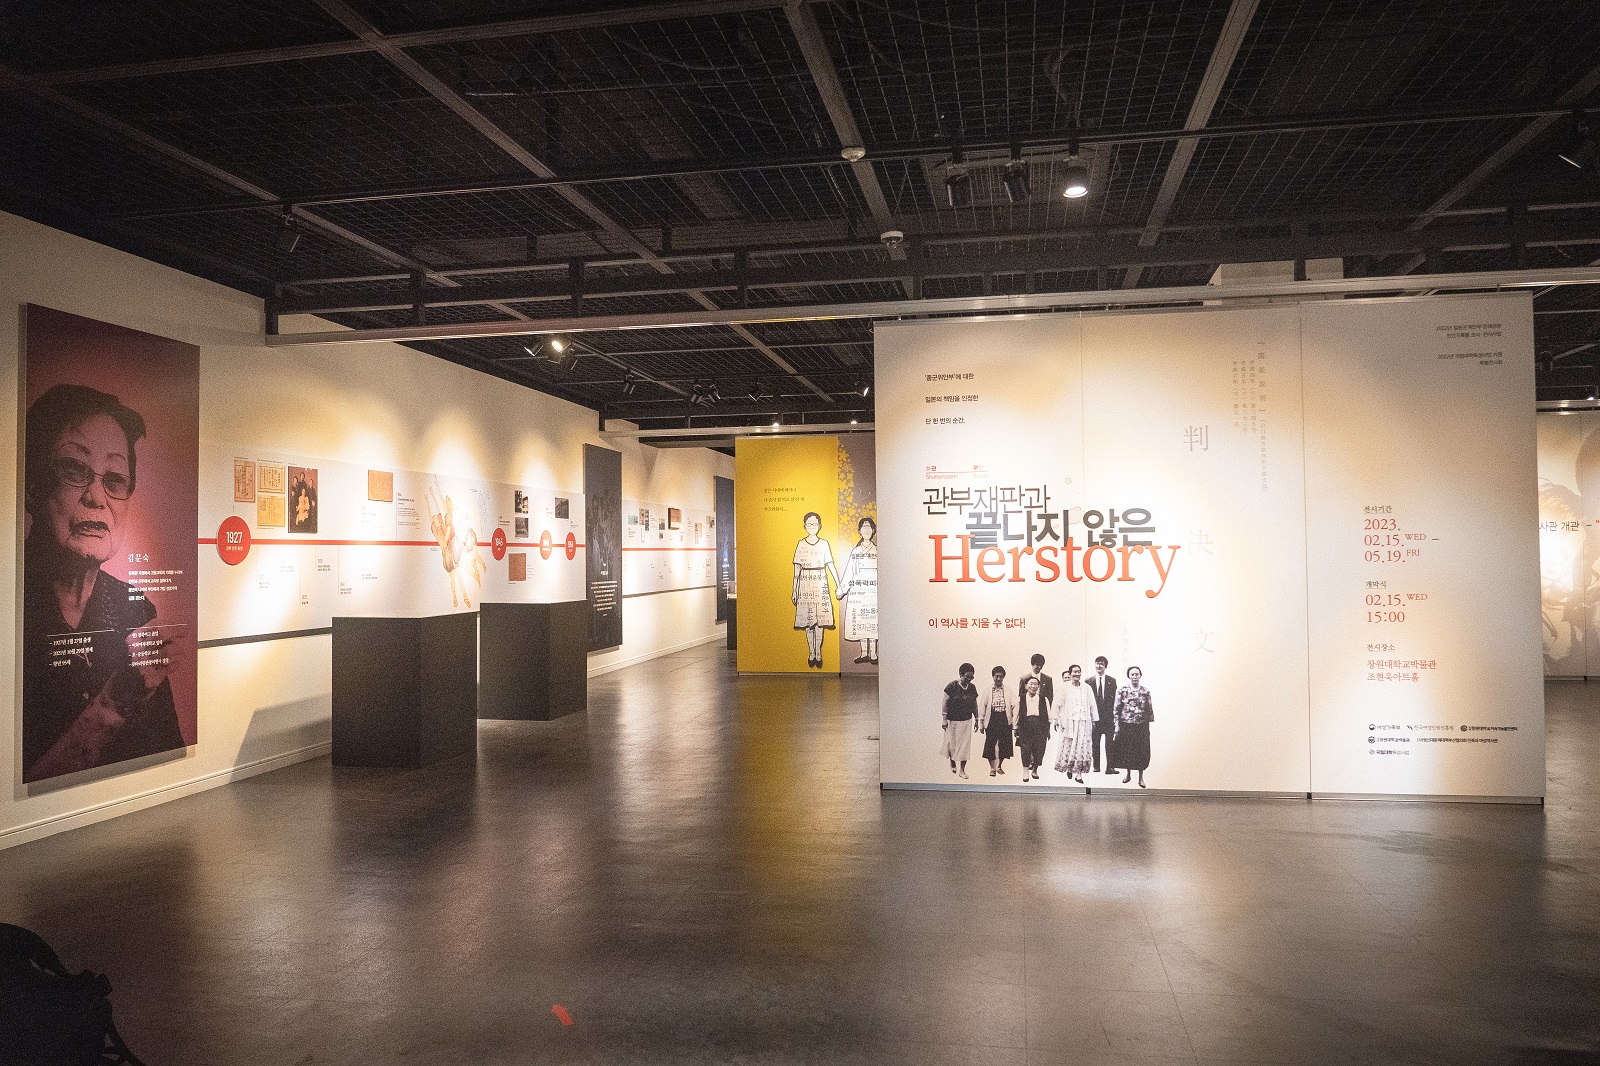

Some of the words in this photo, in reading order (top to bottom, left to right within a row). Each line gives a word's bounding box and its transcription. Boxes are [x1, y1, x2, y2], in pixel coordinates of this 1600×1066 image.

[962, 372, 975, 380] 대한
[924, 395, 942, 403] 일본의
[961, 394, 979, 402] 인정한
[925, 417, 931, 425] 단
[939, 417, 951, 425] 번의
[922, 485, 1051, 515] 관부재판과
[1363, 505, 1392, 513] 전시기간
[966, 508, 1069, 549] 끝나지
[1082, 507, 1156, 549] 않은
[1364, 518, 1401, 531] 2023.
[1561, 521, 1580, 531] 개관
[226, 531, 243, 544] 1927
[1404, 533, 1427, 541] WED
[128, 553, 150, 563] 김문숙
[928, 534, 1182, 598] Herstory
[1365, 580, 1387, 588] 개막식
[1406, 593, 1428, 601] WED
[1367, 611, 1405, 623] 15:00
[857, 622, 879, 631] 여자근로
[928, 618, 938, 629] 이
[940, 617, 969, 629] 역사를
[971, 617, 990, 629] 지울
[992, 618, 1002, 628] 수
[1004, 617, 1026, 629] 없다!
[1366, 643, 1395, 652] 전시장소
[1367, 659, 1437, 670] 창원대학교박물관
